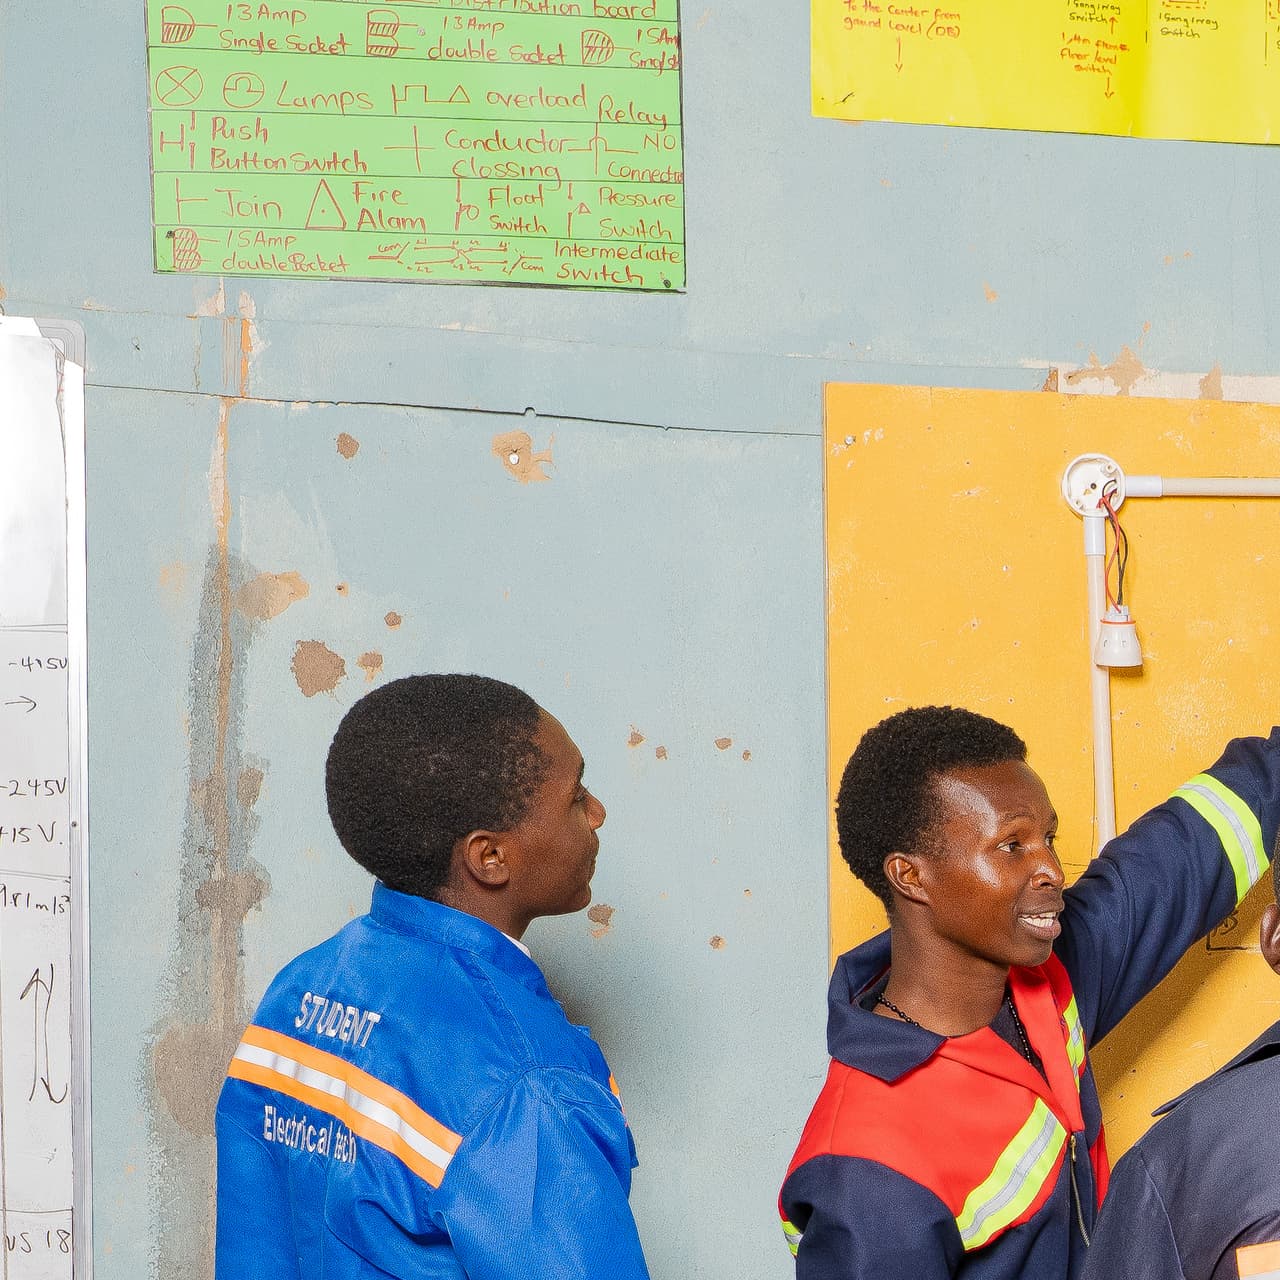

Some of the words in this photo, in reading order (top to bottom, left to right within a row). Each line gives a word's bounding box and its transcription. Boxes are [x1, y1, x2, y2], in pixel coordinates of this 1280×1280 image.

[593, 0, 656, 18] board
[219, 30, 278, 55] Single
[285, 33, 352, 54] Socket
[428, 36, 499, 60] double
[508, 43, 567, 64] Socket
[276, 80, 374, 115] Lamps
[486, 83, 587, 110] overload
[598, 95, 667, 131] Relay
[211, 116, 268, 144] Push
[445, 128, 578, 153] Conductor
[643, 133, 676, 150] NO
[210, 148, 287, 171] Button
[289, 150, 367, 173] Switch
[214, 188, 283, 222] Join
[352, 181, 408, 205] Fire
[489, 215, 548, 234] Switch
[599, 218, 672, 241] Switch
[222, 251, 287, 271] double
[554, 240, 682, 264] Intermediate
[557, 265, 643, 286] Switch
[294, 991, 381, 1047] STUDENT
[263, 1105, 333, 1159] Electrical
[333, 1123, 357, 1164] tech
[46, 1229, 71, 1253] 18
